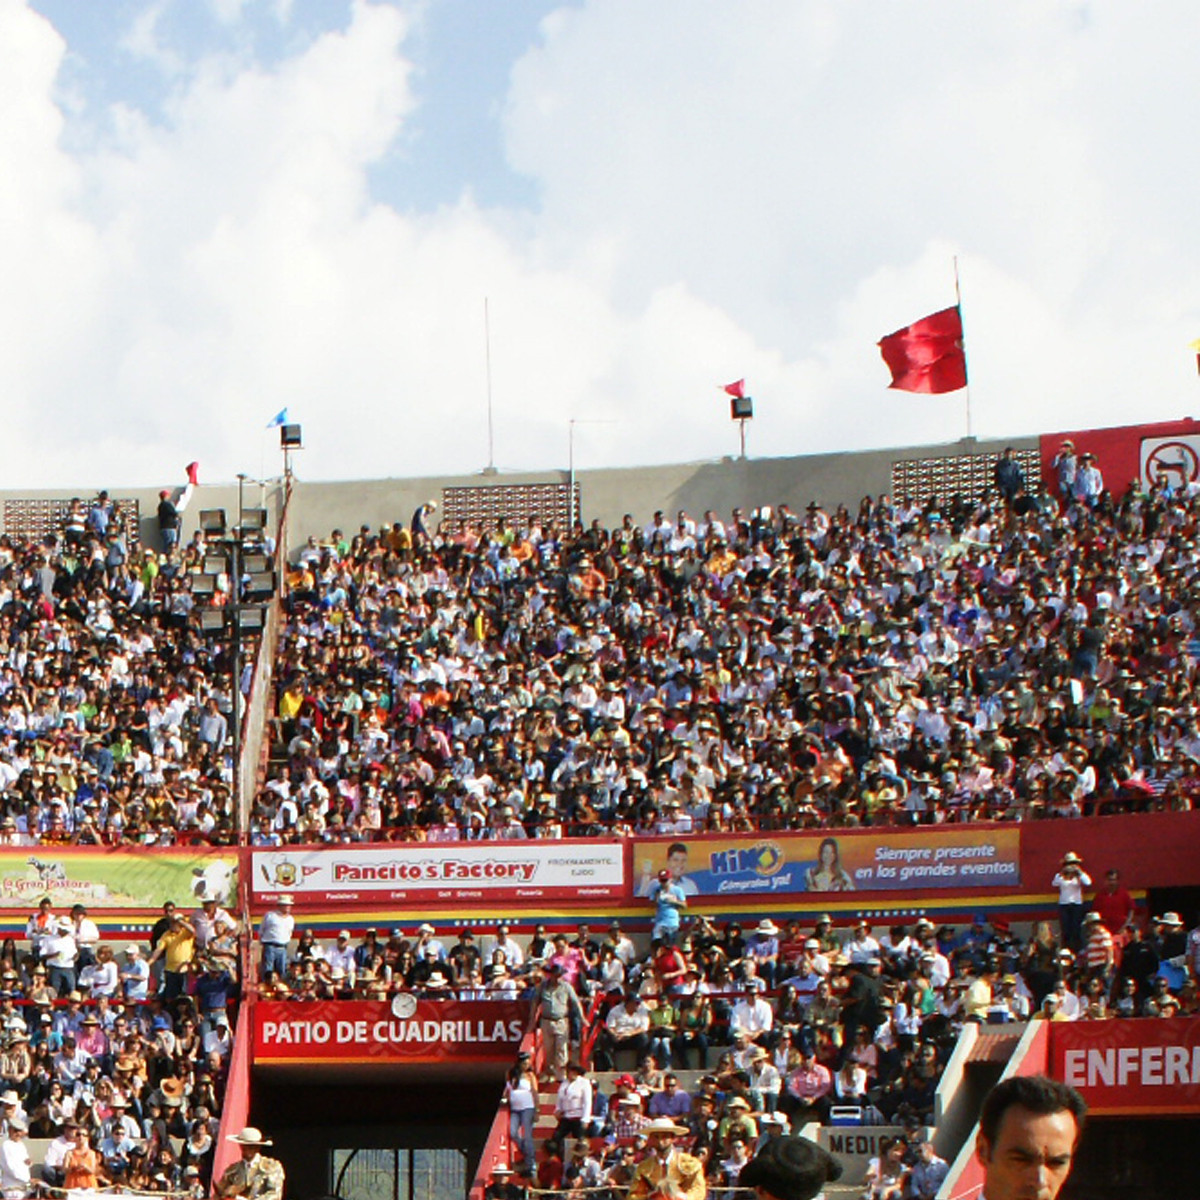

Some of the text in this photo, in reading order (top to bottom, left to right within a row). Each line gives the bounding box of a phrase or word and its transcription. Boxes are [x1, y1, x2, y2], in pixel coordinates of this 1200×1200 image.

[875, 844, 996, 862] Siempre presente
[334, 862, 536, 880] Pancito's Factory
[855, 861, 1016, 881] en los grandes eventos
[263, 1020, 523, 1044] PATIO DE CUADRILLAS
